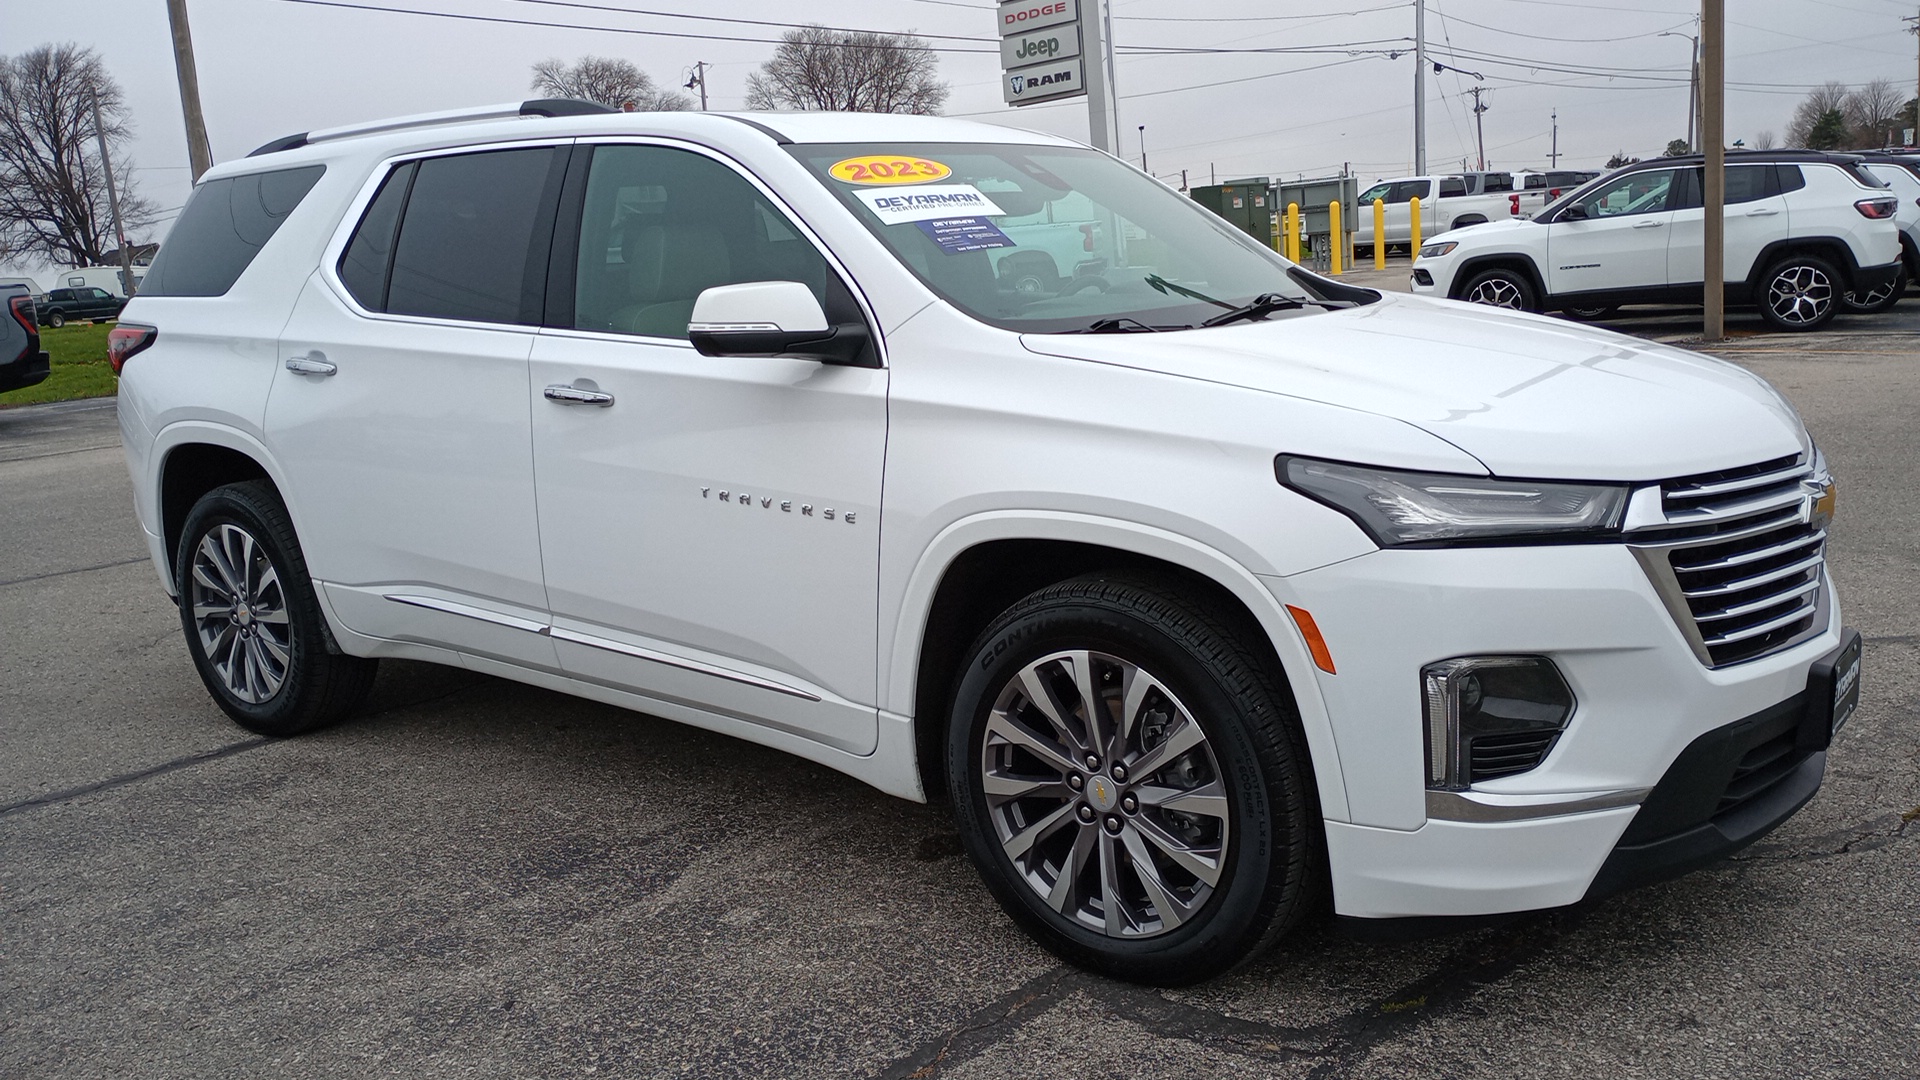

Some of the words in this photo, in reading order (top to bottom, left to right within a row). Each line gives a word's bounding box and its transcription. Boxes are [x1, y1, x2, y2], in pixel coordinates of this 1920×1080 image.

[1005, 2, 1066, 25] DODGE
[1016, 37, 1059, 59] Jeep
[1027, 71, 1071, 88] RAM
[845, 161, 940, 181] 2023
[875, 193, 980, 208] DEYARMAN
[891, 203, 935, 212] CERTIFIED
[936, 201, 985, 209] PRE-OWNED
[701, 486, 856, 524] TRAVERSE
